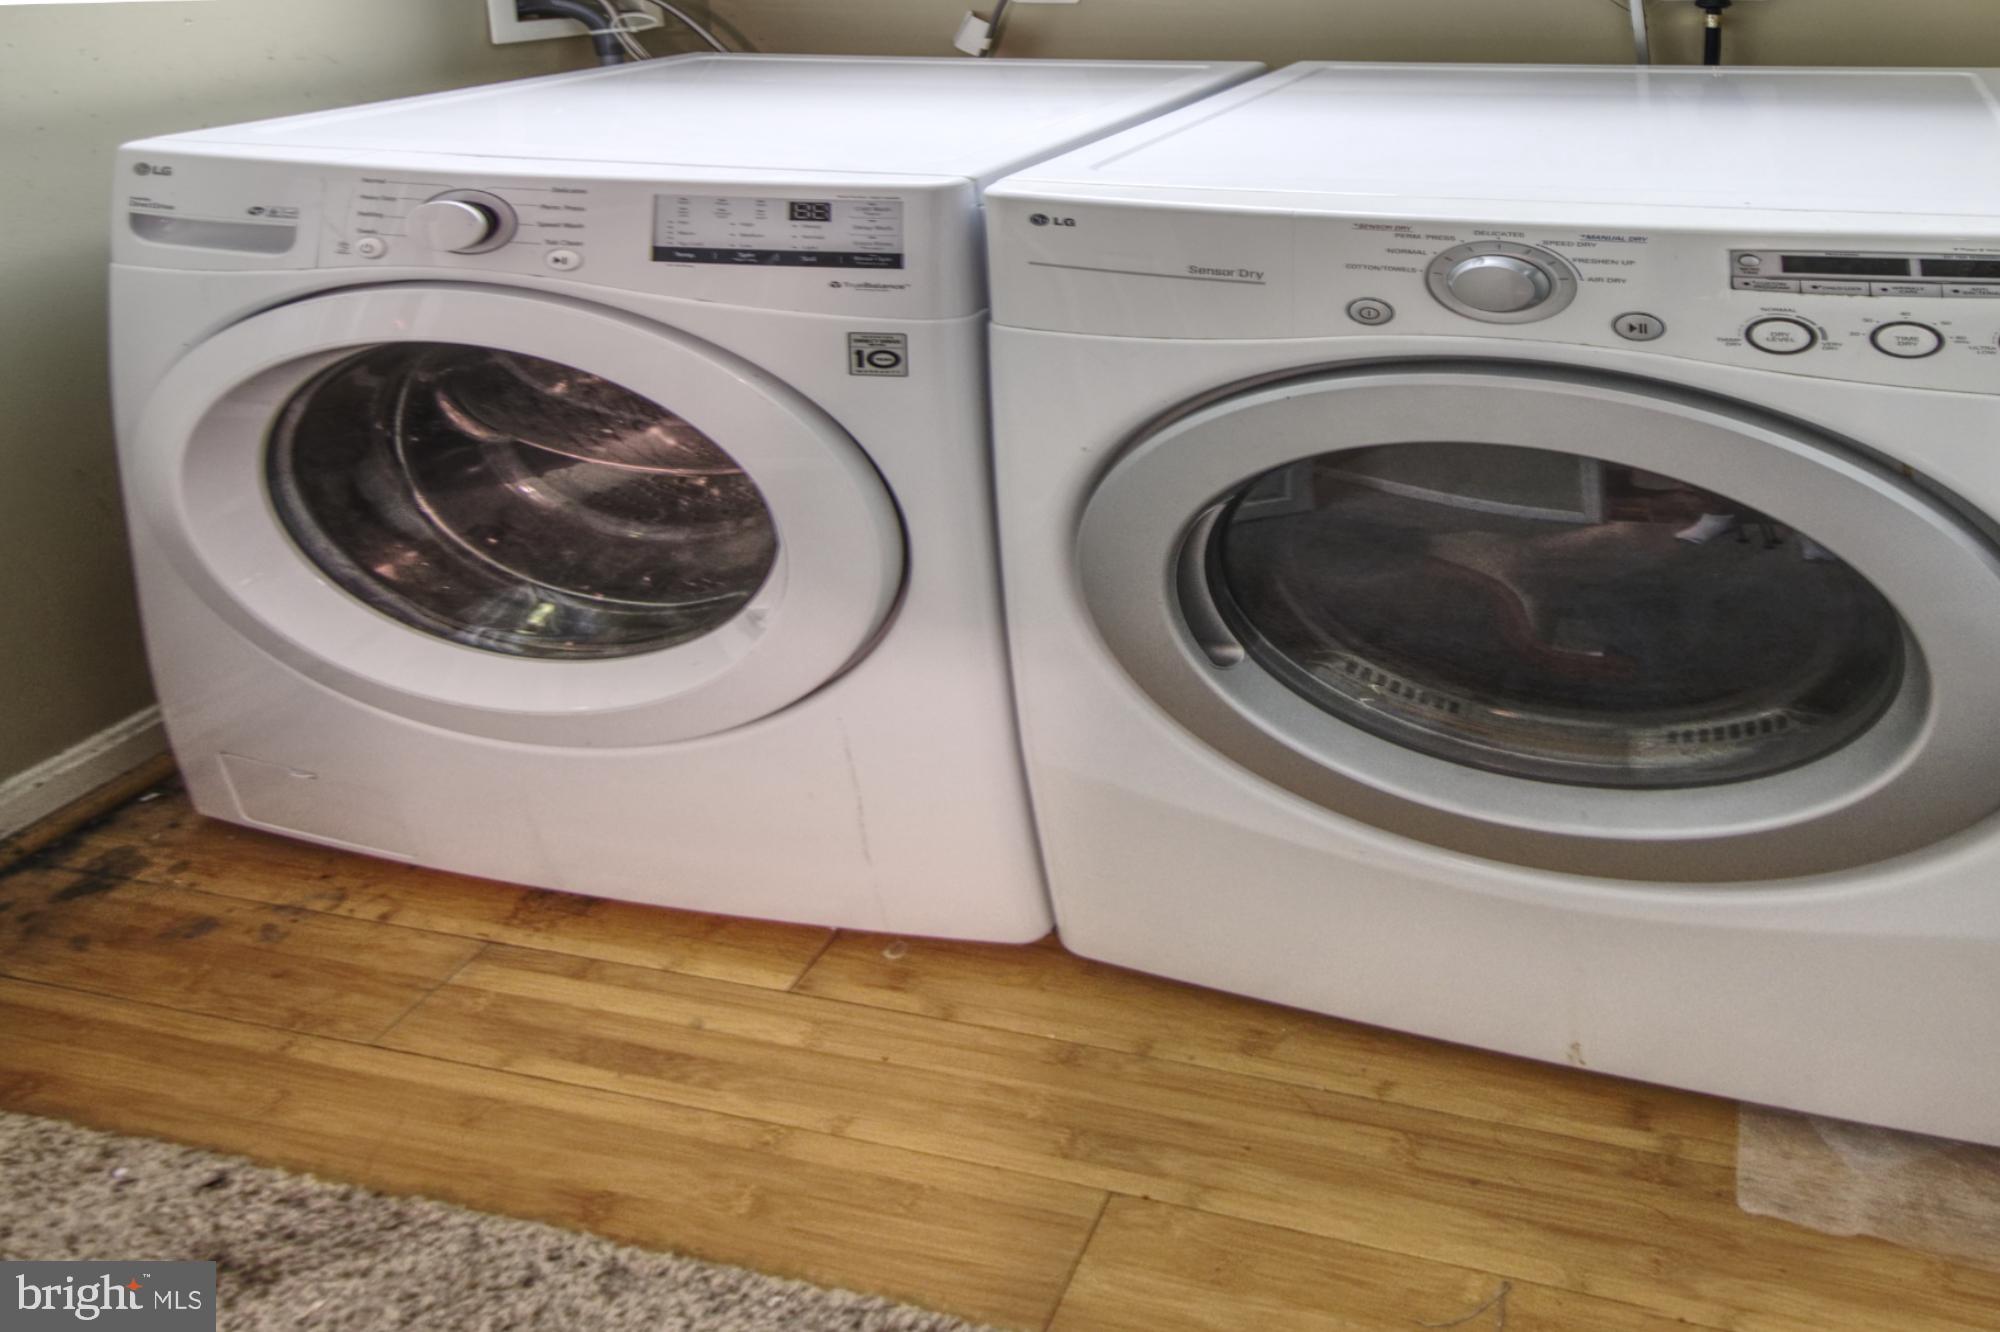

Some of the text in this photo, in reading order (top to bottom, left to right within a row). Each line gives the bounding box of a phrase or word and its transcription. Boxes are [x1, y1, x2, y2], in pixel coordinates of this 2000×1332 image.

[151, 165, 173, 176] LG
[1053, 217, 1076, 227] LG
[1542, 239, 1575, 247] SPEED
[1385, 247, 1428, 255] NORMAL
[1571, 257, 1636, 266] FRESHEN UP
[1187, 263, 1264, 281] Sensor Dry
[1606, 277, 1627, 285] DRY
